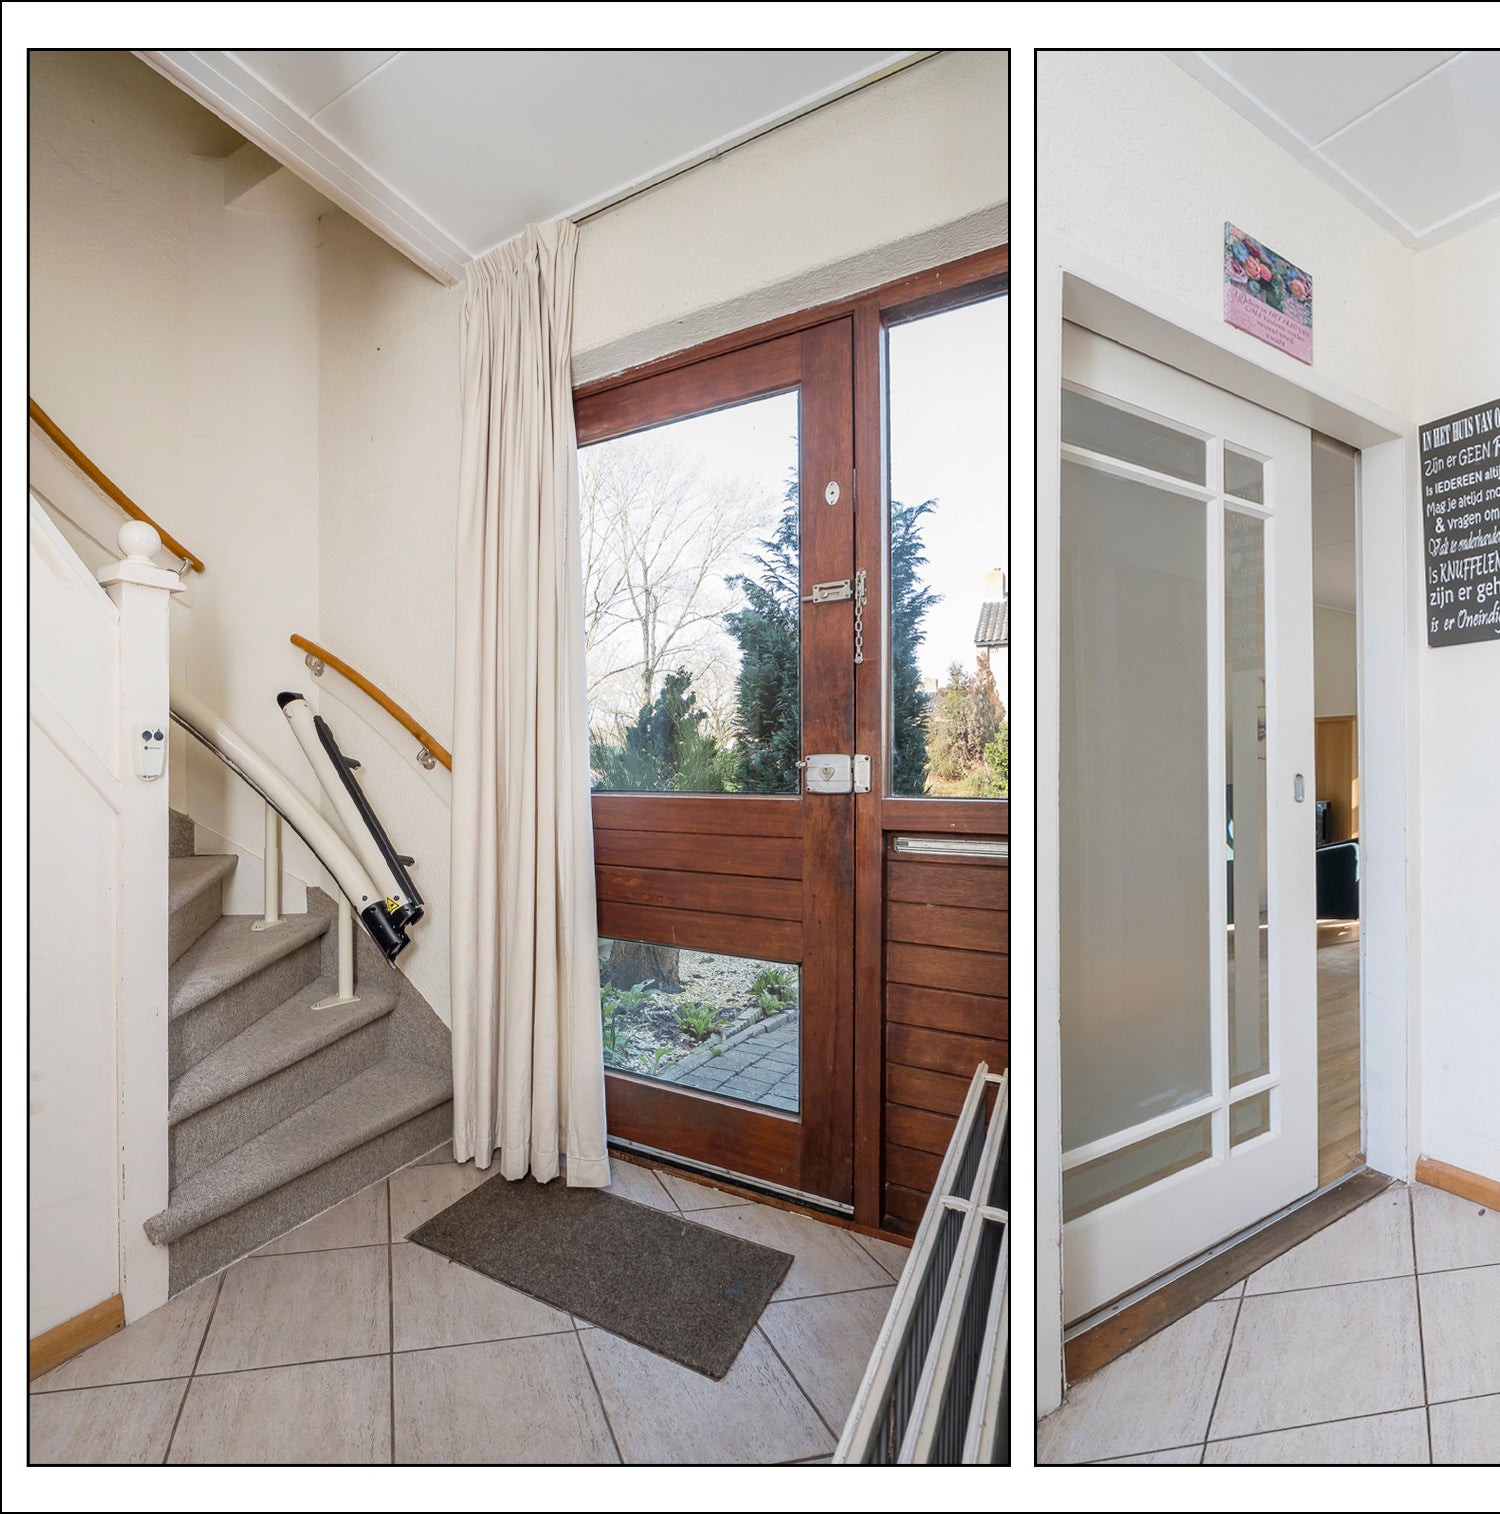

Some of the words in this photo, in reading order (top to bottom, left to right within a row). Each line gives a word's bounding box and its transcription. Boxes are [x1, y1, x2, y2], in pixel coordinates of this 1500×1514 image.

[1423, 431, 1432, 451] IN
[1433, 424, 1451, 448] HET
[1452, 416, 1474, 442] HUIS
[1474, 409, 1493, 434] VAN
[1446, 454, 1457, 468] er
[1459, 441, 1490, 466] GEEN
[1426, 485, 1434, 496] Is
[1435, 470, 1482, 494] IEDEREEN
[1426, 502, 1445, 517] Mag
[1448, 498, 1456, 511] je
[1458, 490, 1483, 508] altijd
[1435, 517, 1445, 533] &
[1447, 512, 1481, 530] vragen
[1484, 507, 1500, 521] om
[1429, 566, 1438, 584] Is
[1430, 587, 1454, 608] zijn
[1458, 586, 1472, 600] er
[1430, 616, 1439, 632] is
[1444, 617, 1455, 631] er
